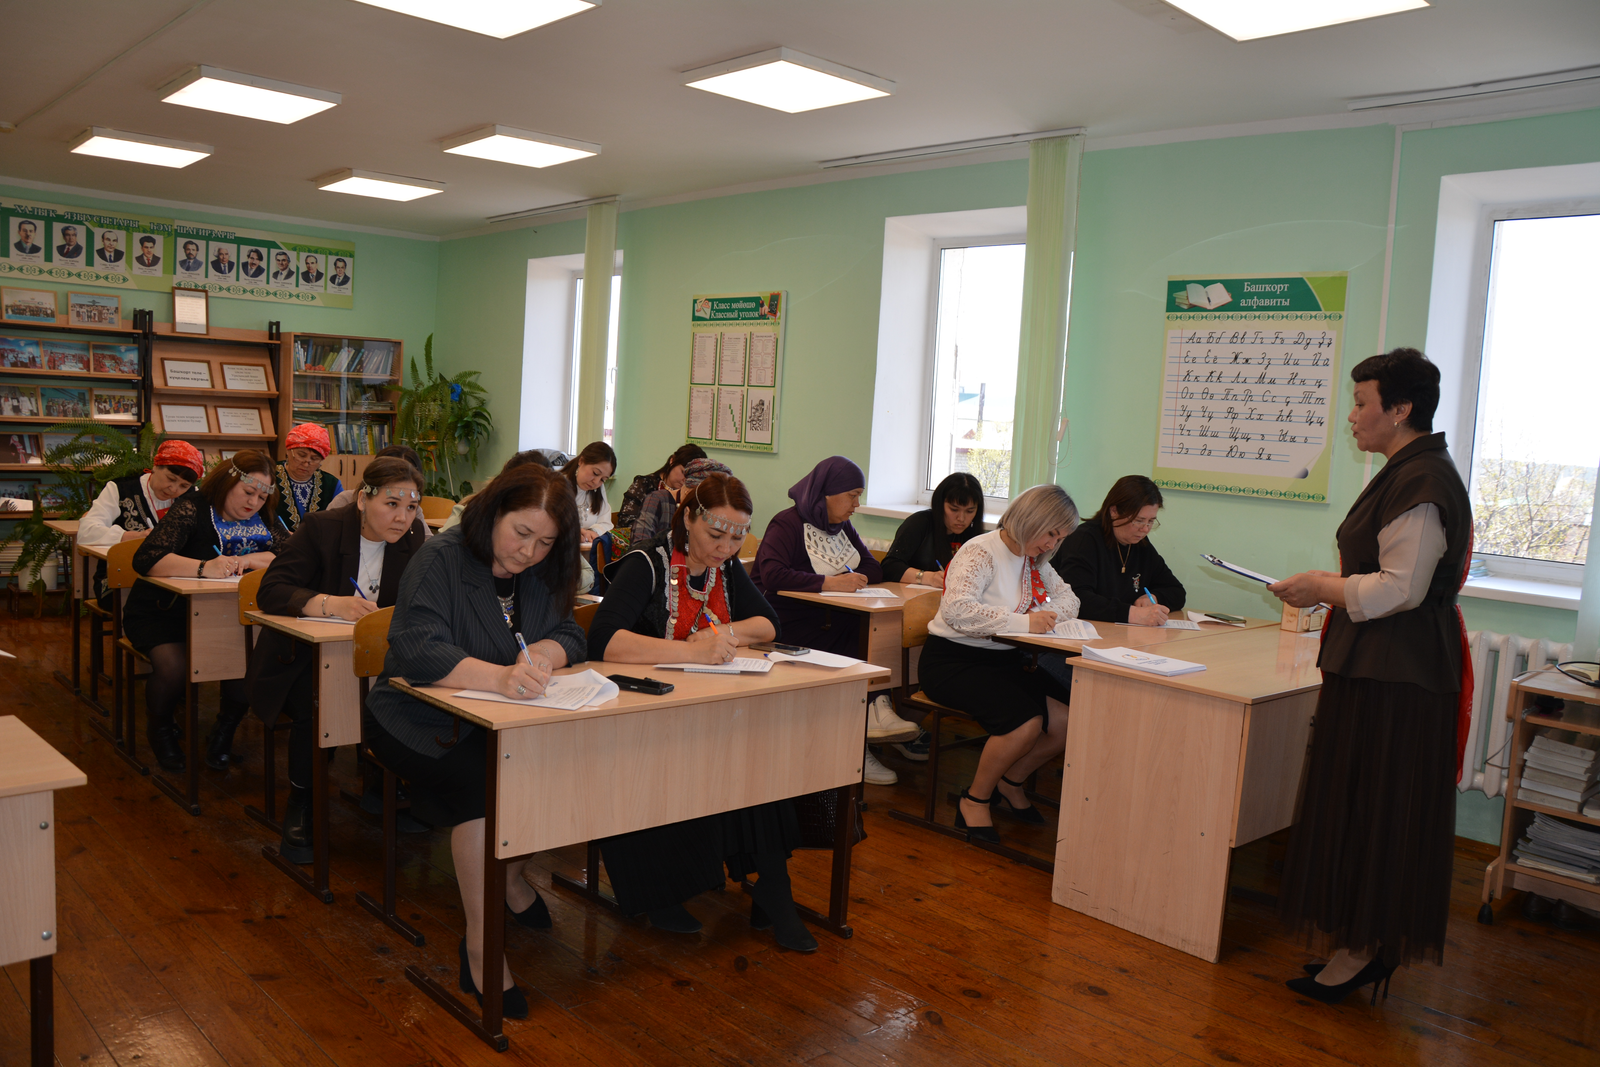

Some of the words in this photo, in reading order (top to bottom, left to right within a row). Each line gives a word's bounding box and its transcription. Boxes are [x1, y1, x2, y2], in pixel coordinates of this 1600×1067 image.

[714, 301, 730, 310] Класс
[1240, 296, 1290, 309] алфавиты
[710, 310, 738, 318] Классный
[738, 310, 760, 320] уголок
